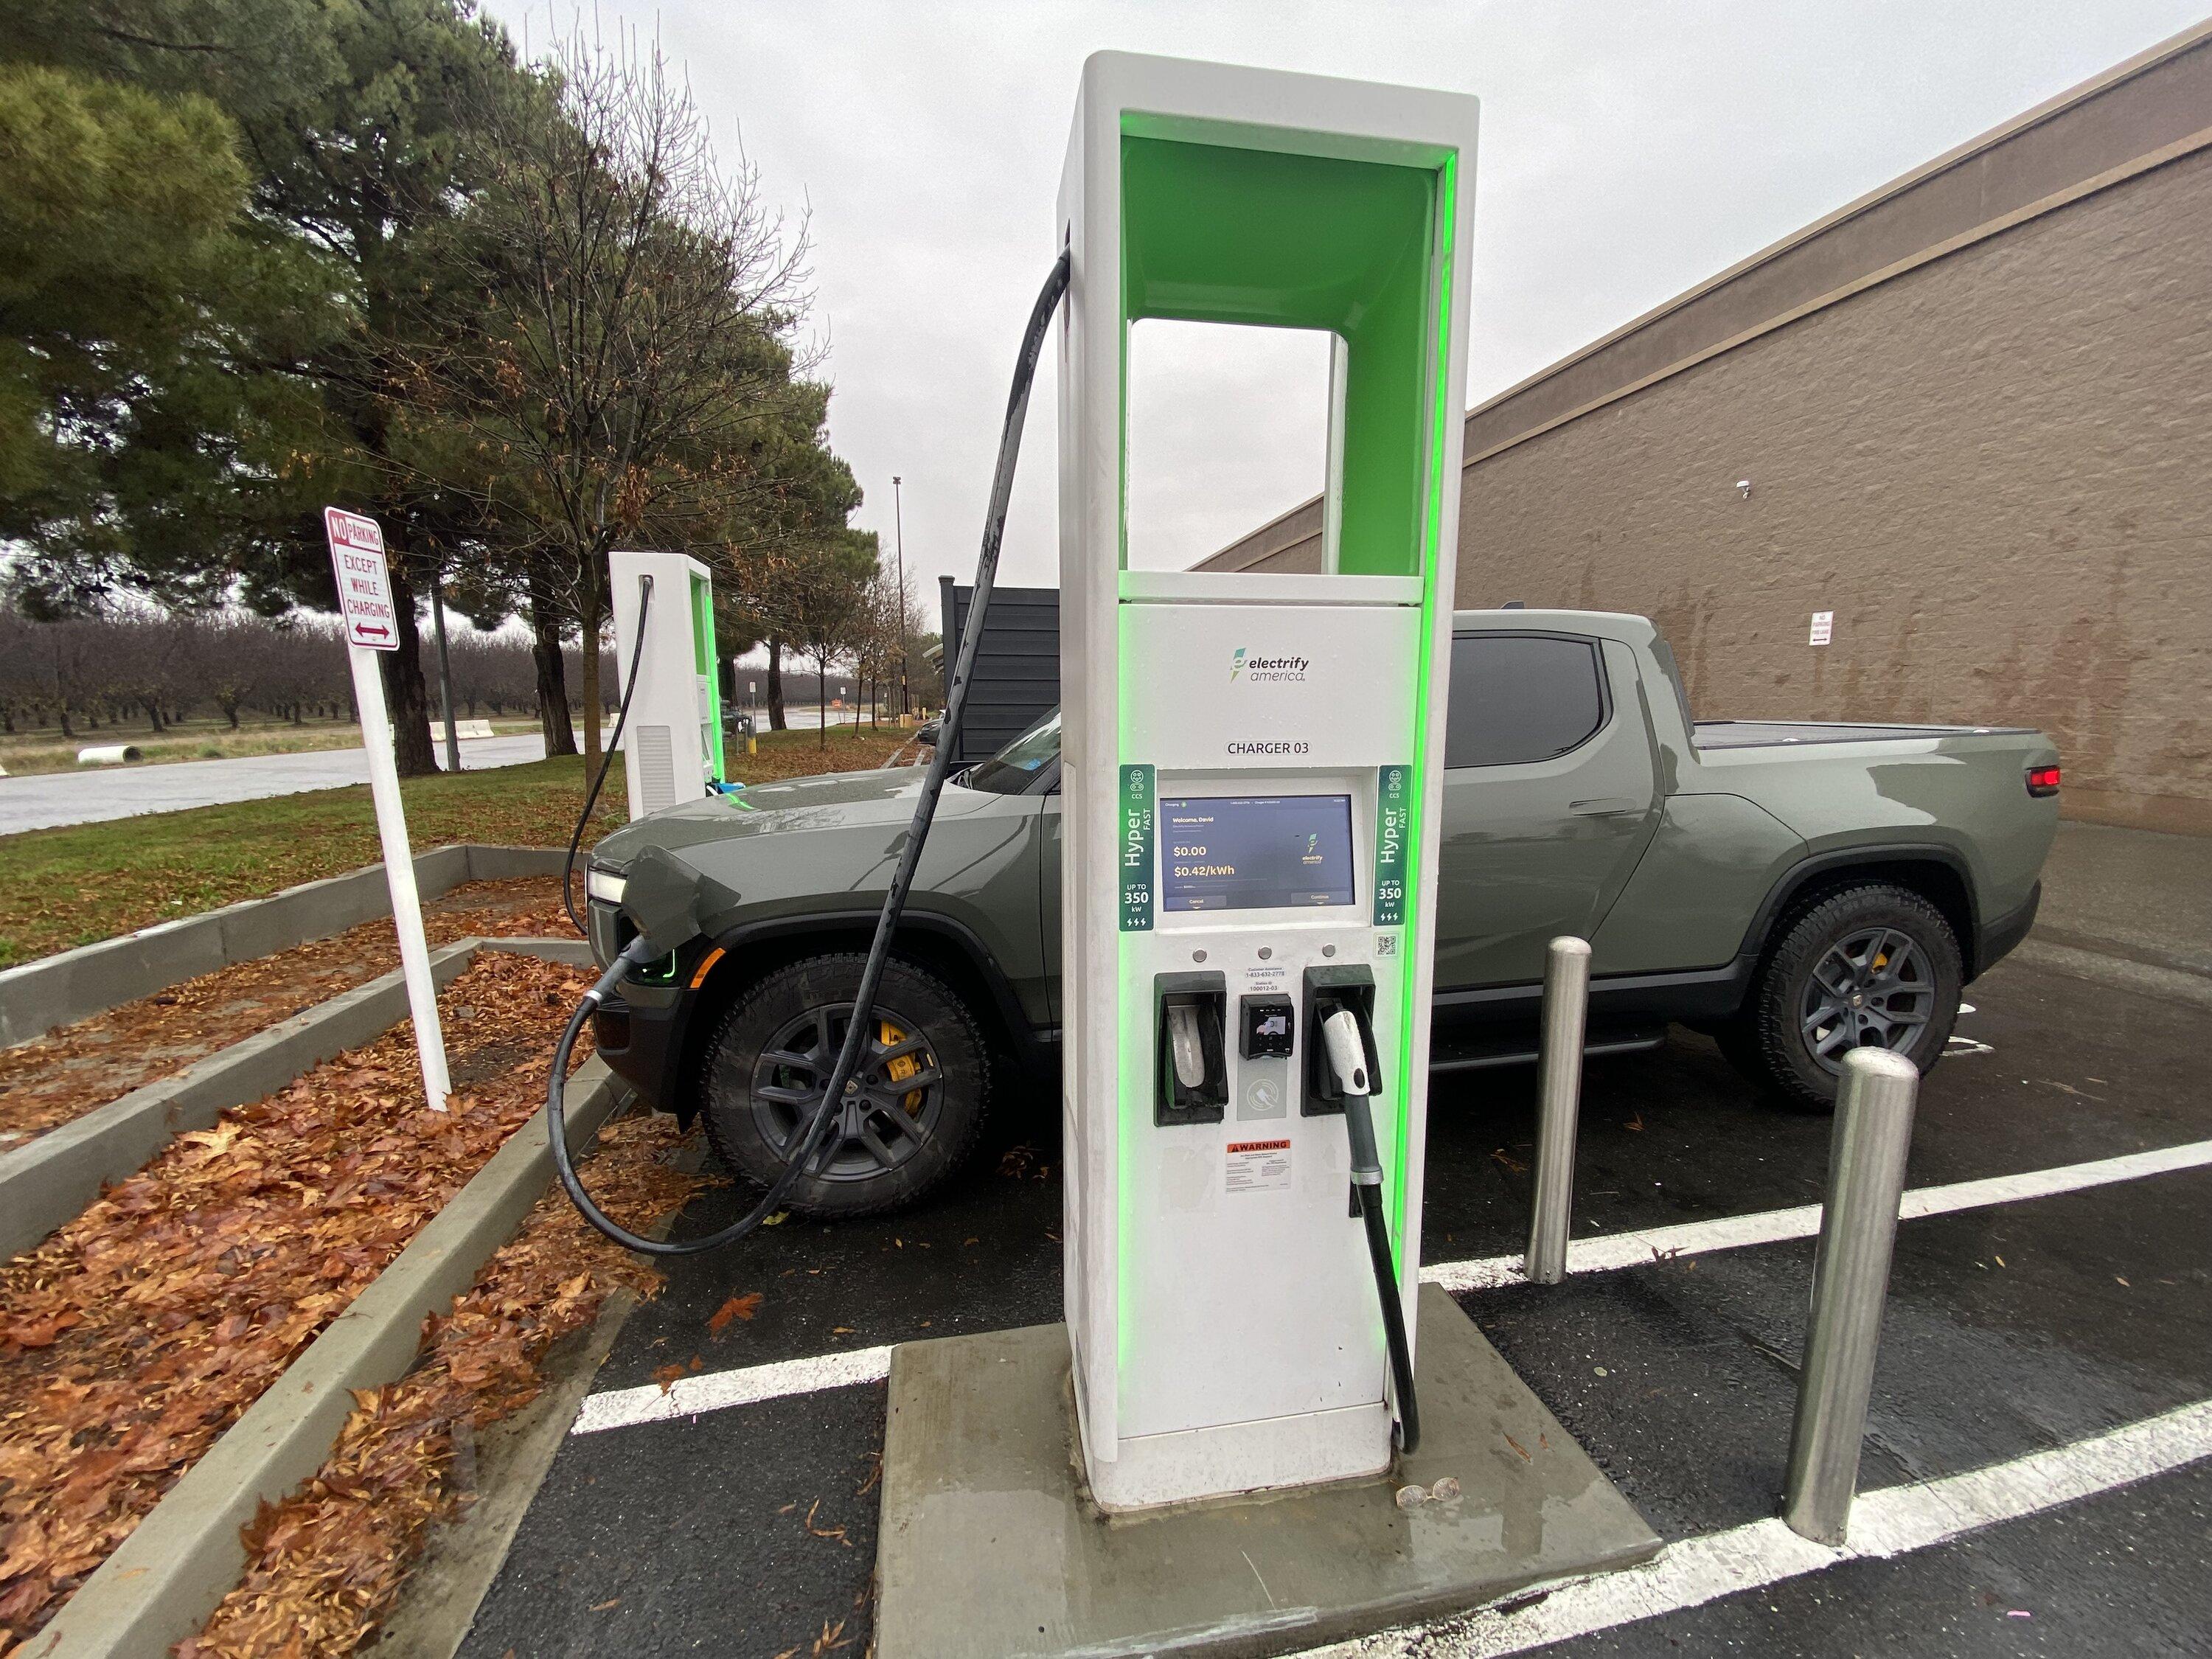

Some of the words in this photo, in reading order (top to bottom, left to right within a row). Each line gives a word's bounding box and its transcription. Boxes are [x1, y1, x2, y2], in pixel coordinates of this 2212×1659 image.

[332, 516, 347, 540] NO
[347, 524, 379, 546] PARKING
[344, 554, 378, 575] EXCEPT
[350, 577, 379, 596] WHILE
[347, 599, 390, 618] CHARGING
[1249, 657, 1310, 671] electrify
[1228, 742, 1290, 754] CHARGER
[1294, 742, 1309, 754] 03
[1399, 807, 1407, 829] FAST
[1124, 808, 1144, 866] Hyper
[1380, 807, 1399, 863] Hyper
[1174, 846, 1206, 858] $0.00
[1174, 865, 1235, 877] $0.42/kWh
[1124, 891, 1149, 904] 350
[1378, 888, 1402, 900] 350
[1239, 1141, 1287, 1151] WARNING
